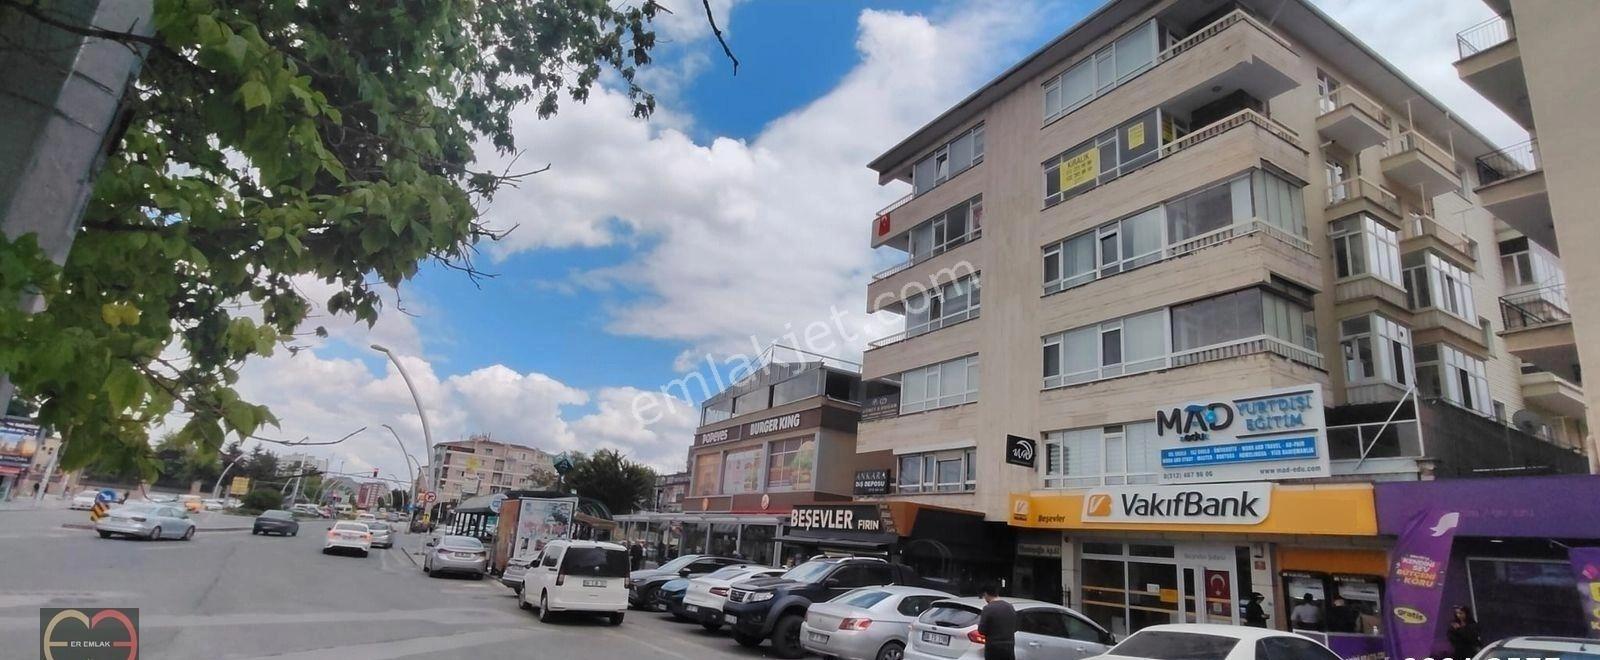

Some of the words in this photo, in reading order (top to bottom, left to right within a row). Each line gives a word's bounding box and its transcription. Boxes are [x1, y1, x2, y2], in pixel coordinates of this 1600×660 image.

[750, 418, 778, 436] BURGER
[779, 413, 800, 430] KING
[1157, 402, 1234, 437] MAD
[856, 471, 886, 480] ANKARA
[1121, 490, 1260, 518] VakıfBank
[791, 509, 853, 531] BEŞEVLER
[857, 519, 880, 531] FIRIN
[1038, 514, 1066, 524] Beşevler
[1397, 609, 1424, 620] gratis
